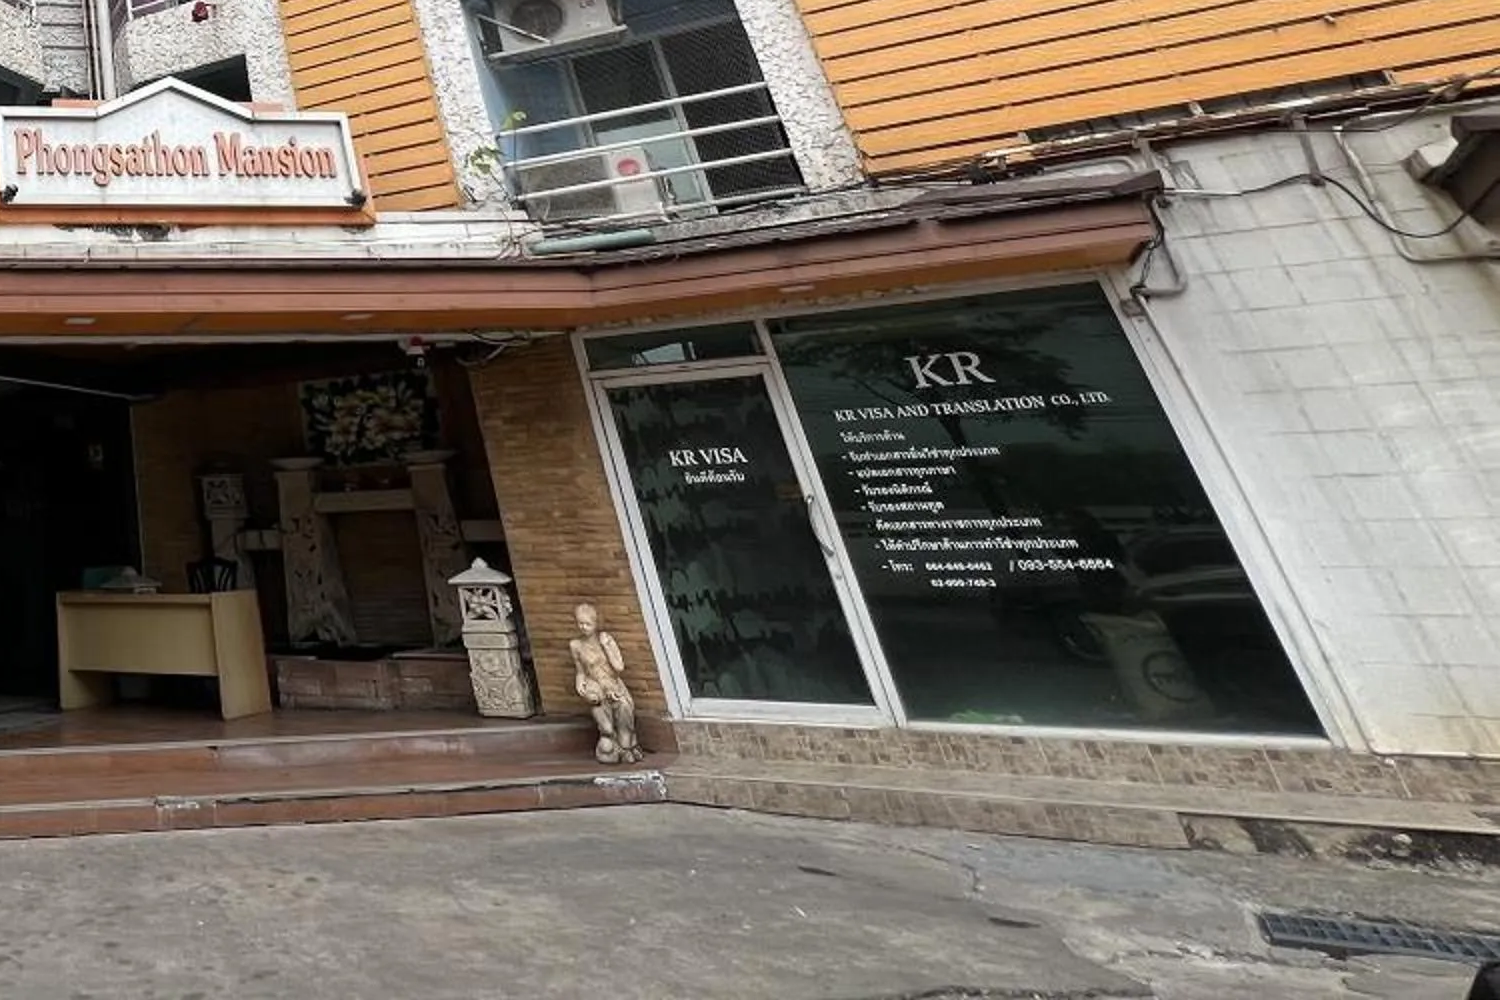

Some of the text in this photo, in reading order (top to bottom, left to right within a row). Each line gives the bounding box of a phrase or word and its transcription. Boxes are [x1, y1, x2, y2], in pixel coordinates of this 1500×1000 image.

[13, 127, 338, 187] Phongsathon Mansion
[903, 351, 996, 389] KR
[834, 408, 859, 423] KR
[859, 407, 895, 421] VISA
[896, 404, 929, 418] AND
[930, 395, 1047, 416] TRANSLATION
[668, 447, 749, 467] KR VISA
